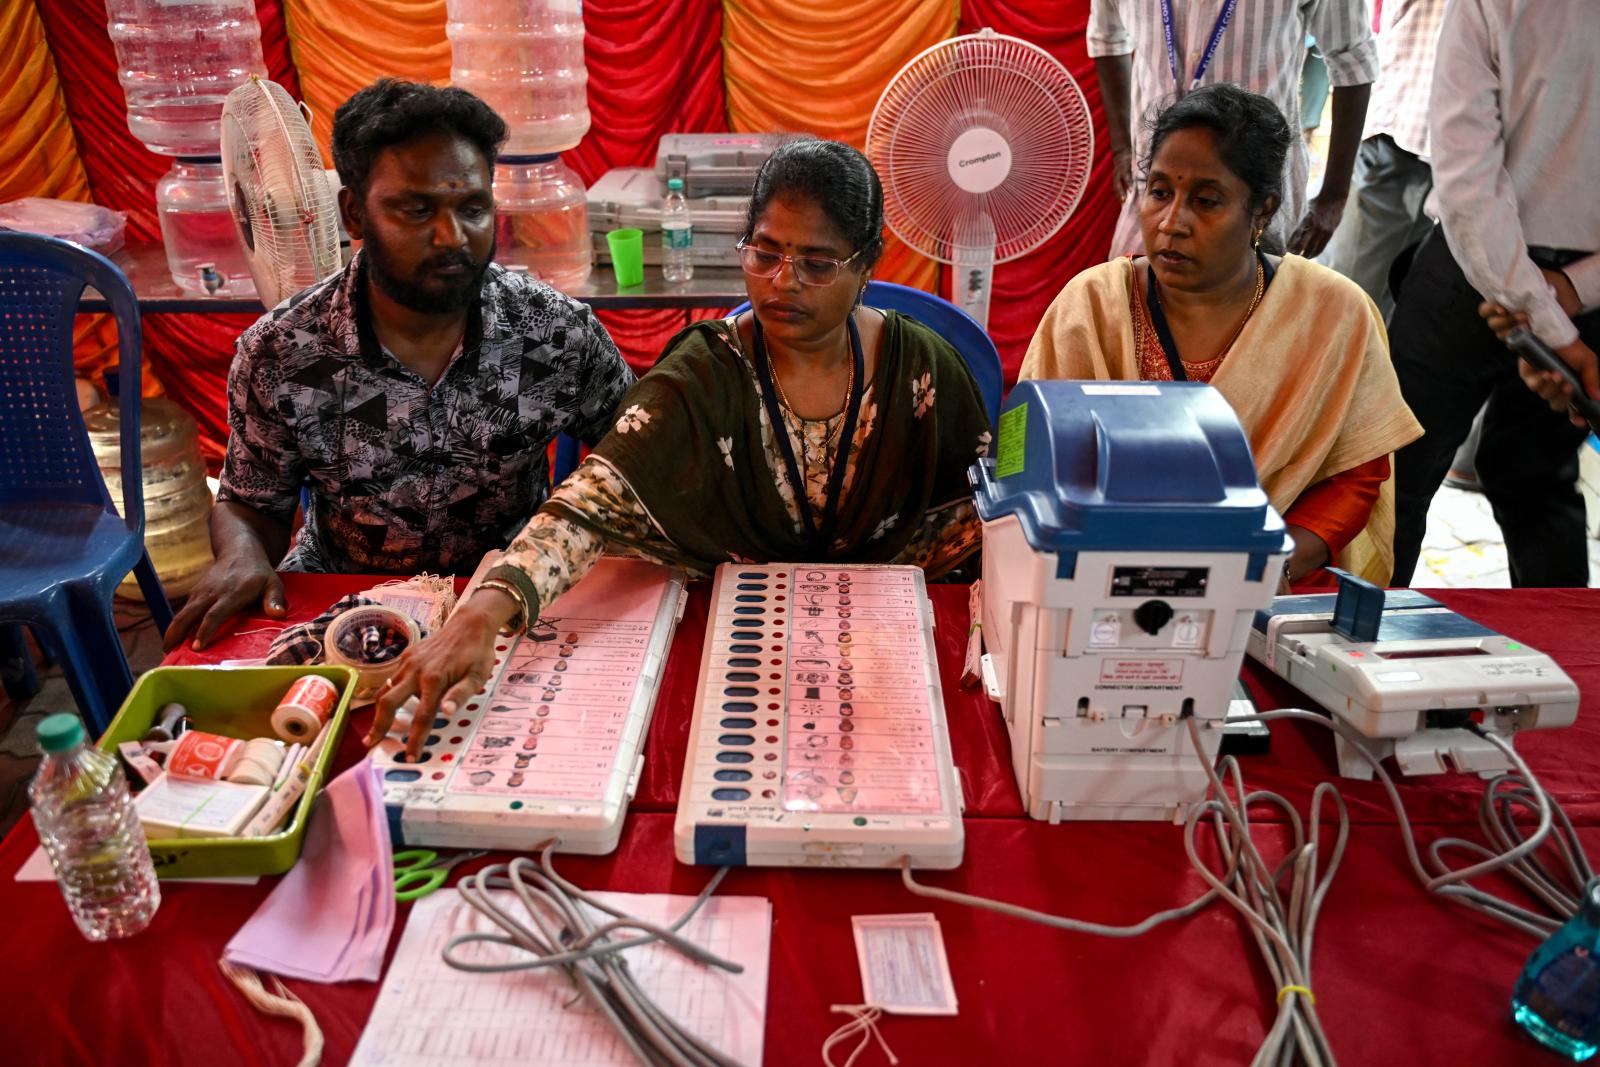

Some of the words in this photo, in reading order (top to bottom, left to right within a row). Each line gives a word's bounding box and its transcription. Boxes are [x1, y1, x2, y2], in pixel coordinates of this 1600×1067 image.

[1202, 25, 1225, 69] ELECTION
[958, 151, 1002, 168] Crompton
[1148, 579, 1176, 588] VVPAT
